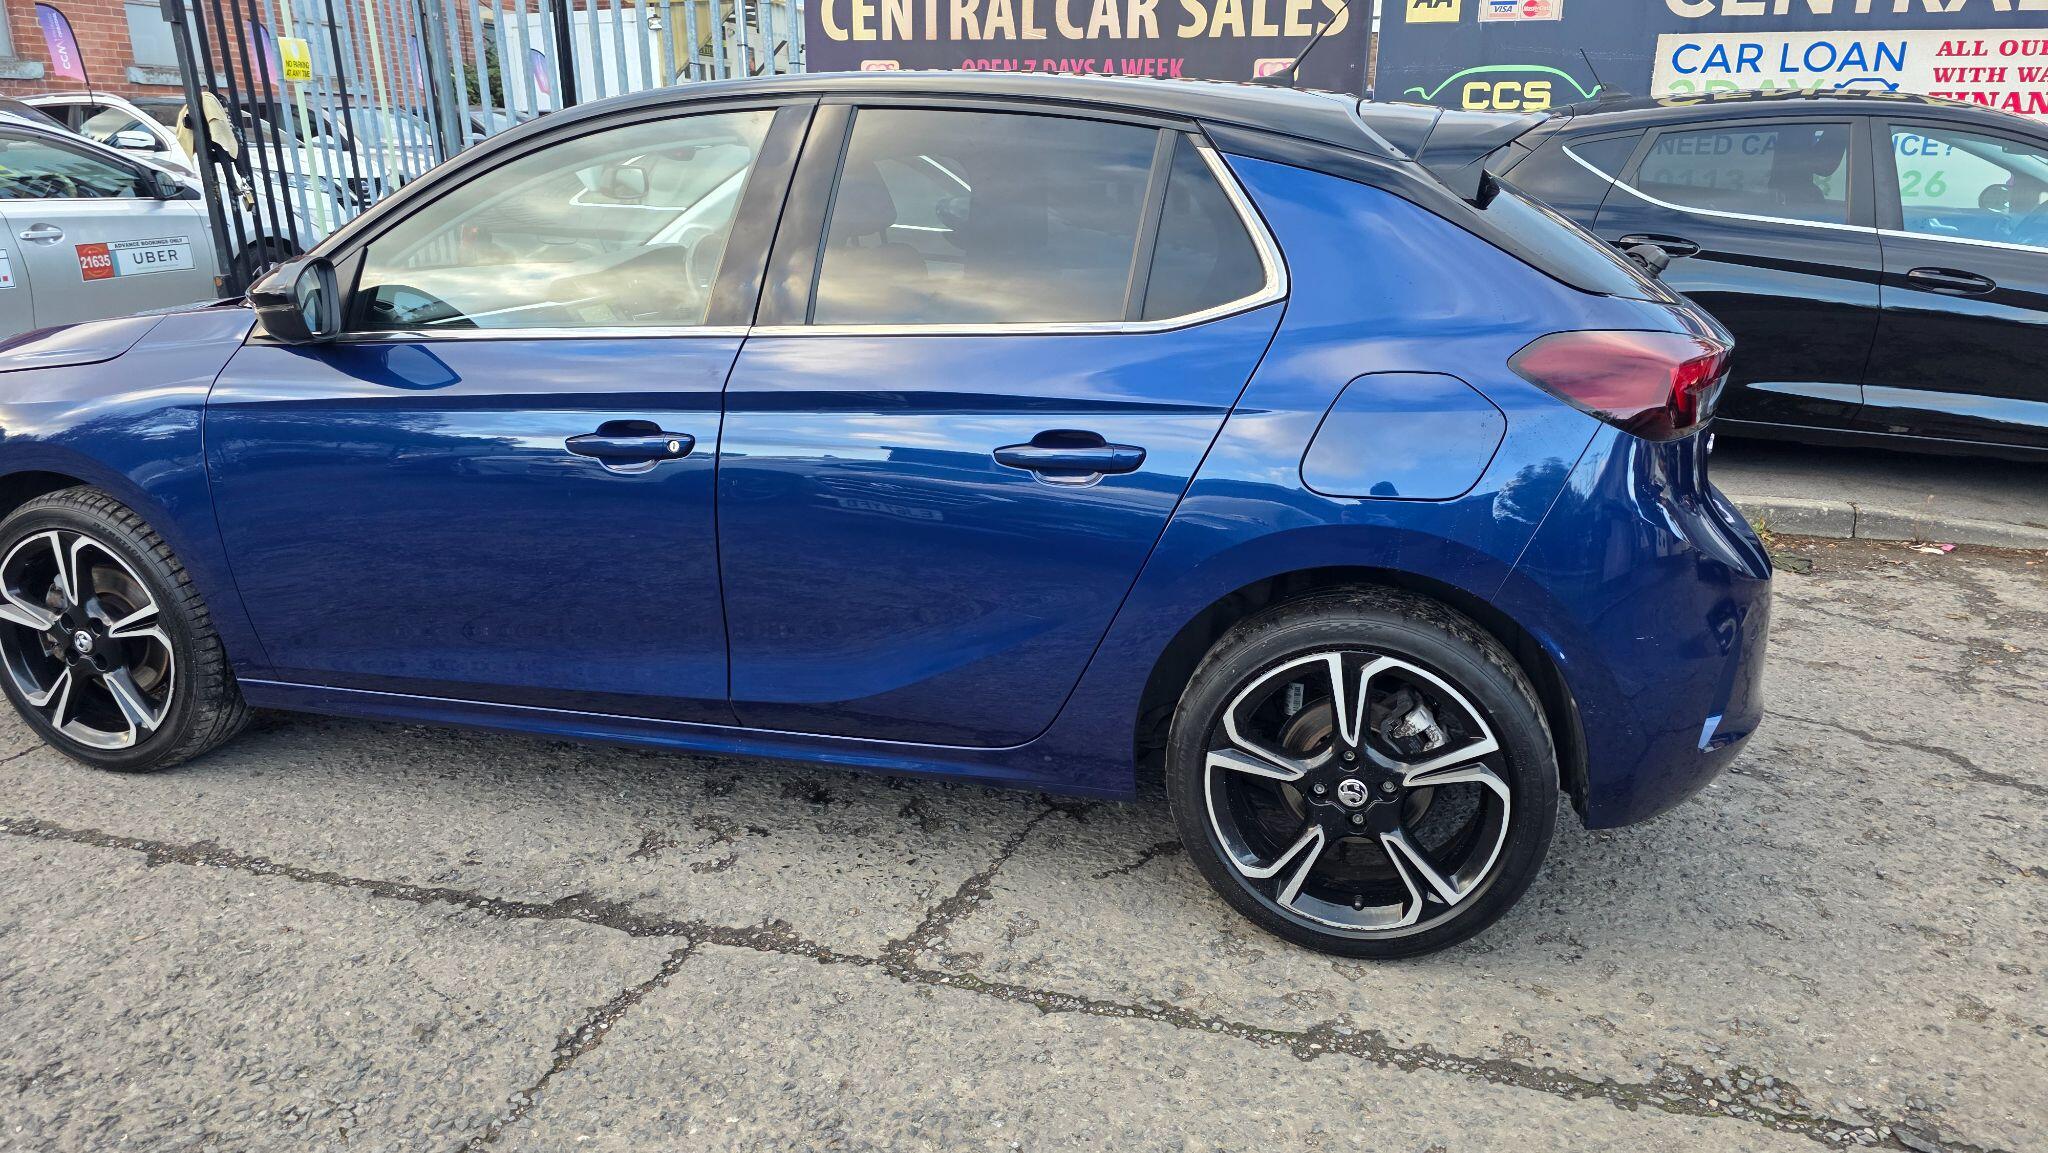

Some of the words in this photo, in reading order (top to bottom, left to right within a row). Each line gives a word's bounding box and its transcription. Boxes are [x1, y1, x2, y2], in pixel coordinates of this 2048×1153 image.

[1494, 5, 1513, 13] VISA
[821, 0, 1047, 42] CENTRAL
[1055, 0, 1160, 40] CAR
[1177, 0, 1350, 39] SALES
[1671, 43, 1764, 74] CAR
[1780, 41, 1907, 73] LOAN
[1935, 40, 1989, 57] ALL
[962, 58, 1018, 72] OPEN
[1023, 59, 1037, 74] 7
[1043, 58, 1096, 75] DAYS
[1103, 58, 1115, 75] A
[1121, 58, 1186, 77] WEEK
[1933, 67, 2008, 83] WITH
[1461, 81, 1552, 113] CCS
[1928, 92, 2048, 115] NAN
[1657, 134, 1733, 156] NEED
[114, 241, 141, 249] ADVANCE
[80, 254, 111, 269] 21635
[132, 249, 179, 265] UBER
